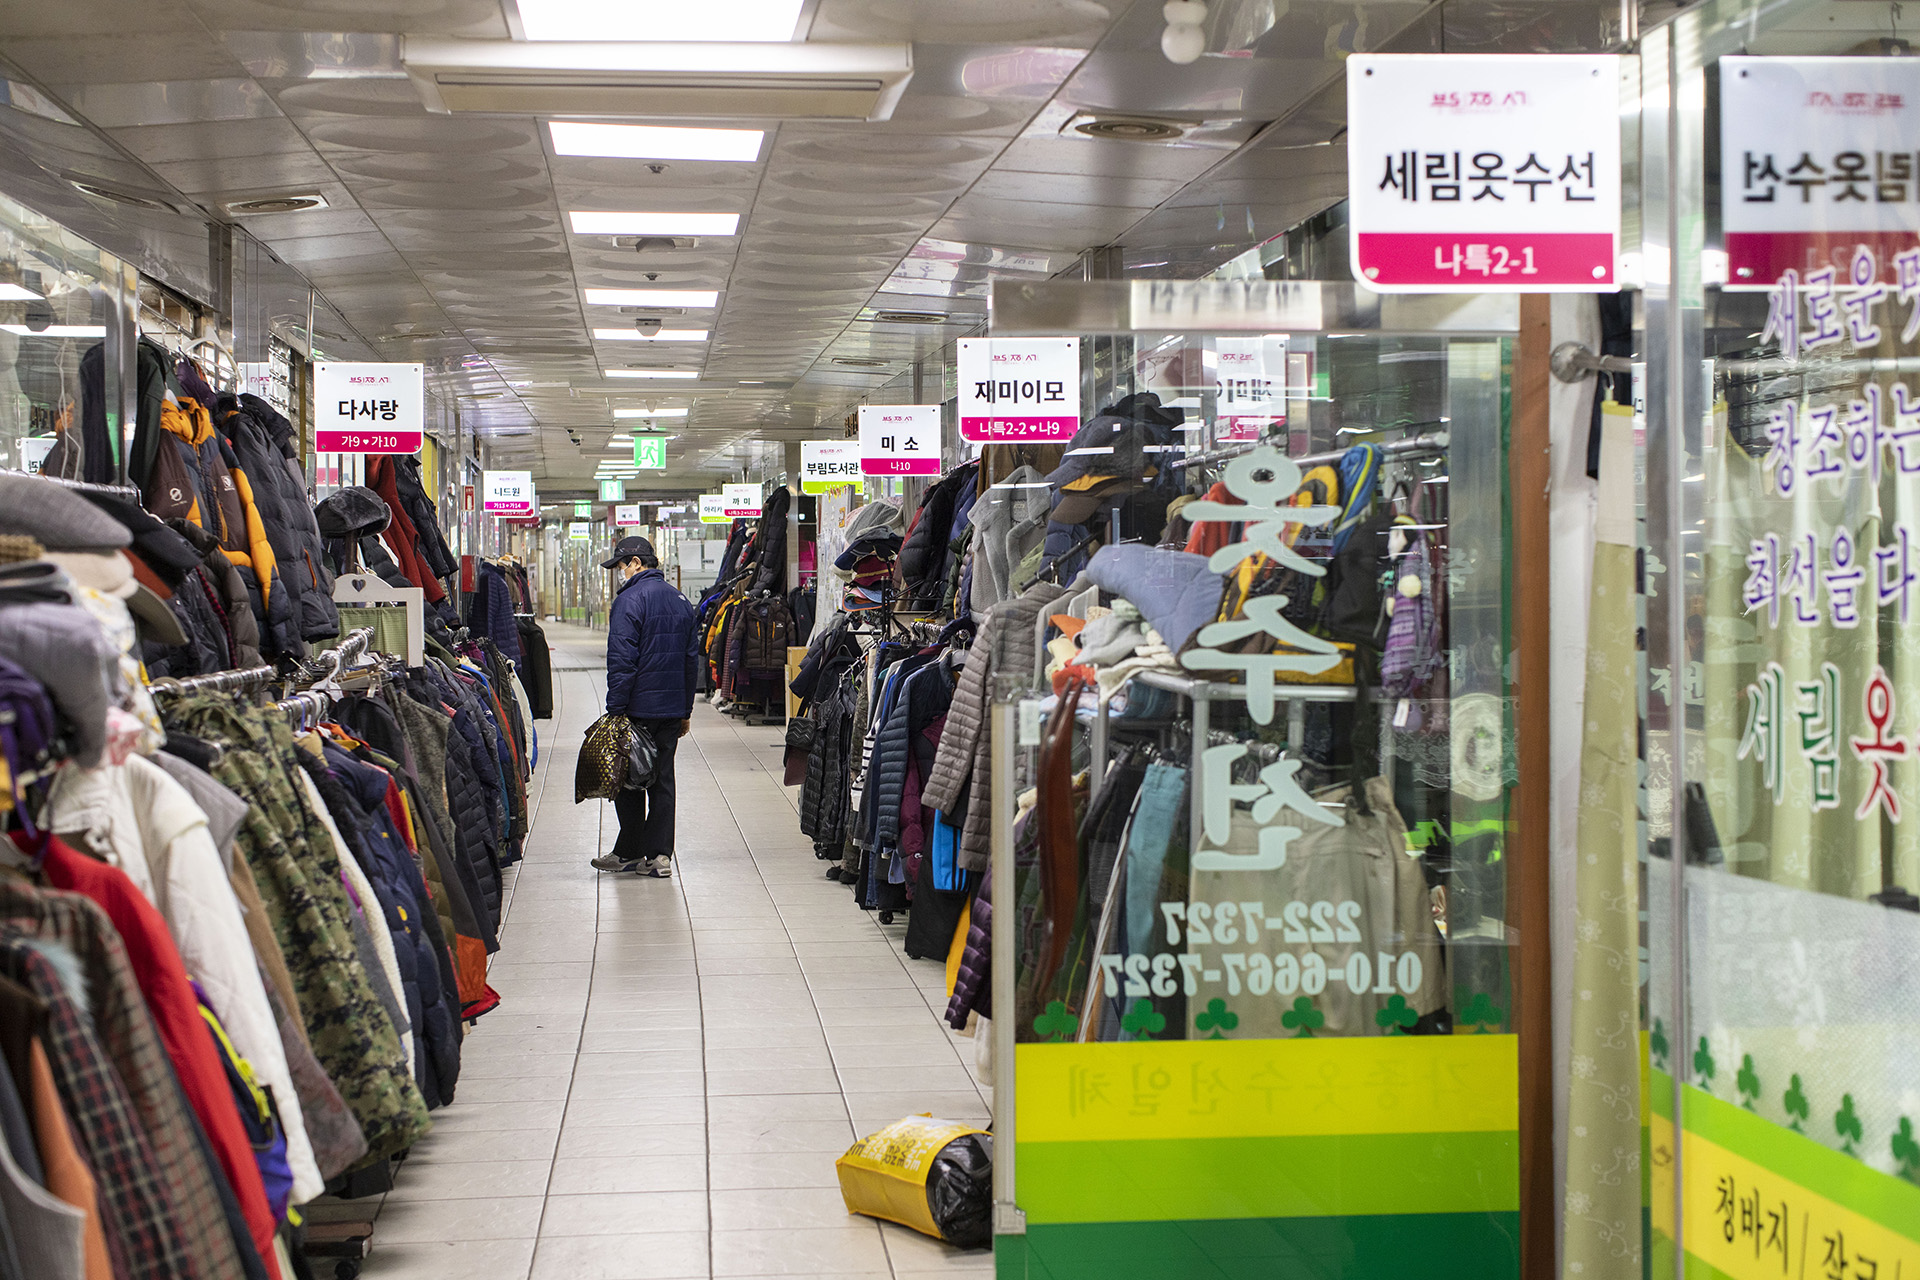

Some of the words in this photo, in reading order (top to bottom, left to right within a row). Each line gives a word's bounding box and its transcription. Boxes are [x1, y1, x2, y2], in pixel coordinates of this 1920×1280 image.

[1378, 150, 1597, 203] 세림옷수선
[1434, 242, 1539, 277] 나특2-1
[1760, 244, 1888, 362] 새로운
[975, 380, 1065, 403] 재미이모
[338, 399, 399, 421] 다사랑
[979, 421, 1027, 436] 나특2-2
[1038, 421, 1060, 436] 나9
[341, 435, 361, 448] 가9
[371, 435, 398, 448] 가10
[806, 462, 859, 475] 부림도서관
[890, 461, 911, 471] 나10
[1743, 526, 1864, 629] 최선을
[1715, 1175, 1788, 1277] 청바지
